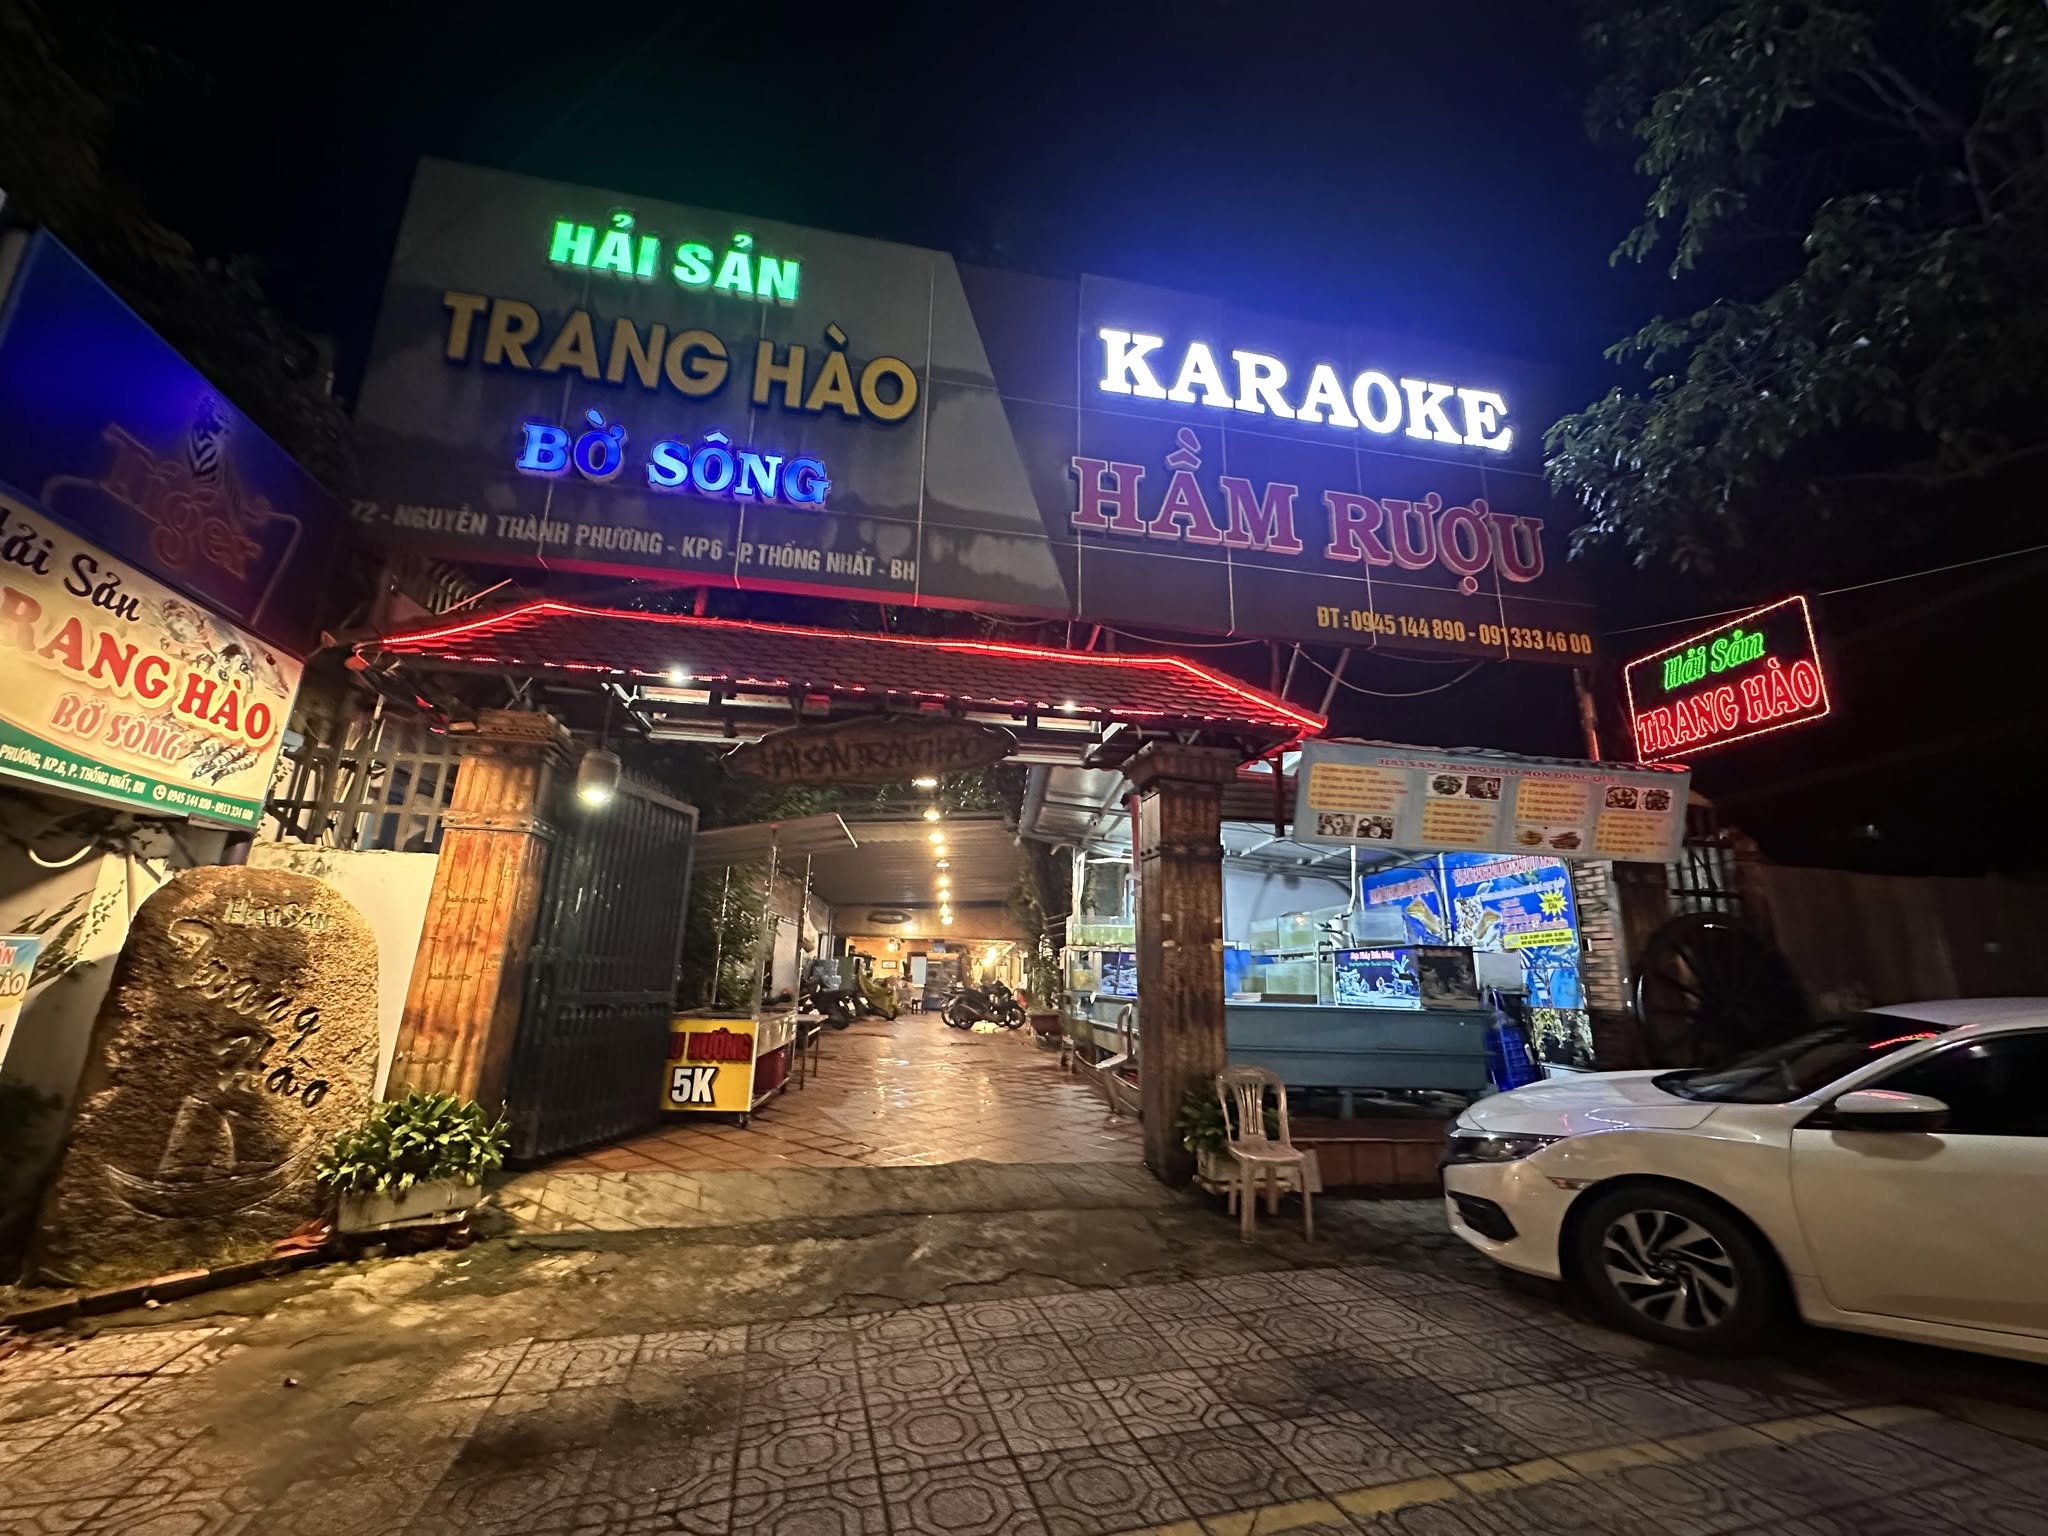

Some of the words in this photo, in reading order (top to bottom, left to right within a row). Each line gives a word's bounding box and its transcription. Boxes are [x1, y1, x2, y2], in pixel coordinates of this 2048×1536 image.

[549, 212, 661, 280] HẢI
[674, 232, 801, 302] SẢN
[443, 290, 729, 398] TRANG
[752, 322, 920, 422] HÀO
[1098, 328, 1514, 452] KARAOKE
[516, 408, 627, 479] BỜ
[647, 430, 833, 510] SÔNG
[392, 502, 490, 537] NGUYỄN
[496, 513, 570, 546] THÀNH
[573, 524, 665, 556] PHƯƠNG
[681, 534, 723, 561] KP6
[757, 538, 822, 572] THỐNG
[826, 546, 875, 578] NHẤT
[889, 558, 917, 582] BH
[1071, 426, 1304, 555] HẦM
[1323, 490, 1545, 596] RƯỢU
[0, 506, 53, 576] ải
[63, 552, 141, 622] Sản
[1397, 615, 1431, 639] 144
[1431, 618, 1466, 643] 890
[1662, 645, 1707, 692] Hải
[1710, 629, 1767, 674] Sản
[104, 713, 182, 762] SÔNG
[177, 672, 271, 740] HÀO
[1636, 686, 1741, 754] TRANG
[1740, 656, 1821, 724] HÀO
[79, 765, 109, 786] THỐNG
[670, 1066, 719, 1104] 5K
